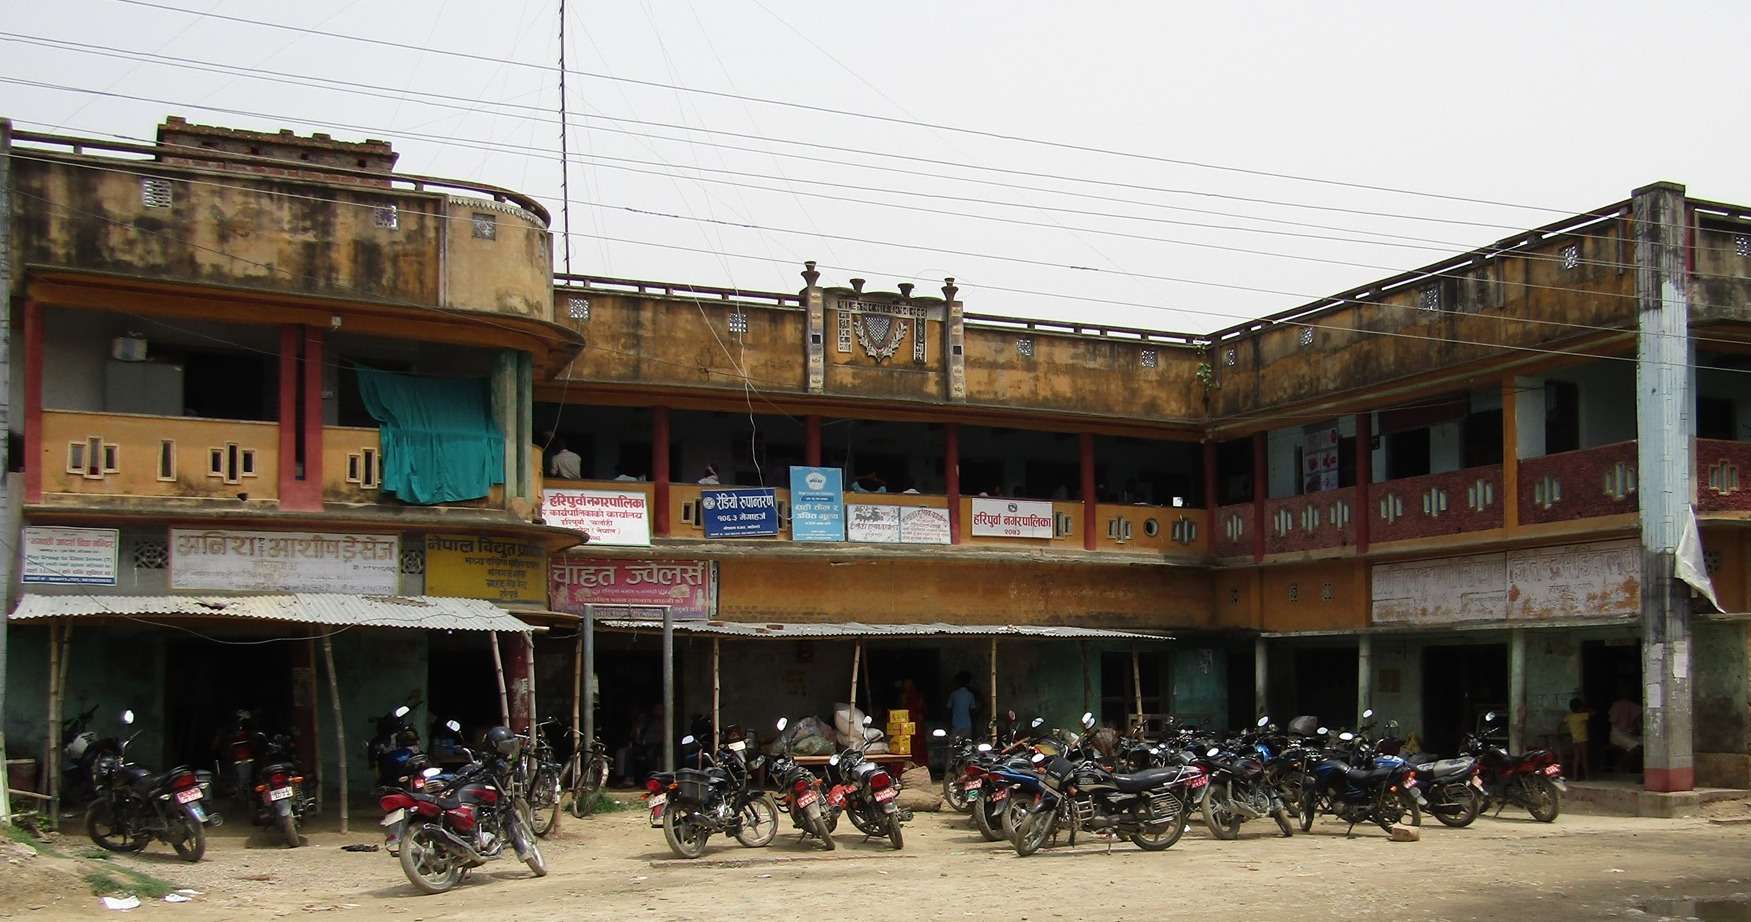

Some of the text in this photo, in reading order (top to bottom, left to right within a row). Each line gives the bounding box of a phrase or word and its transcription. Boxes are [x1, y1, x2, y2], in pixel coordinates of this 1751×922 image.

[716, 493, 738, 510] रेडियो
[1002, 513, 1052, 528] नगरपालिका
[427, 536, 474, 553] नेपाल
[552, 561, 705, 588] चाहत ज्वेलर्स
